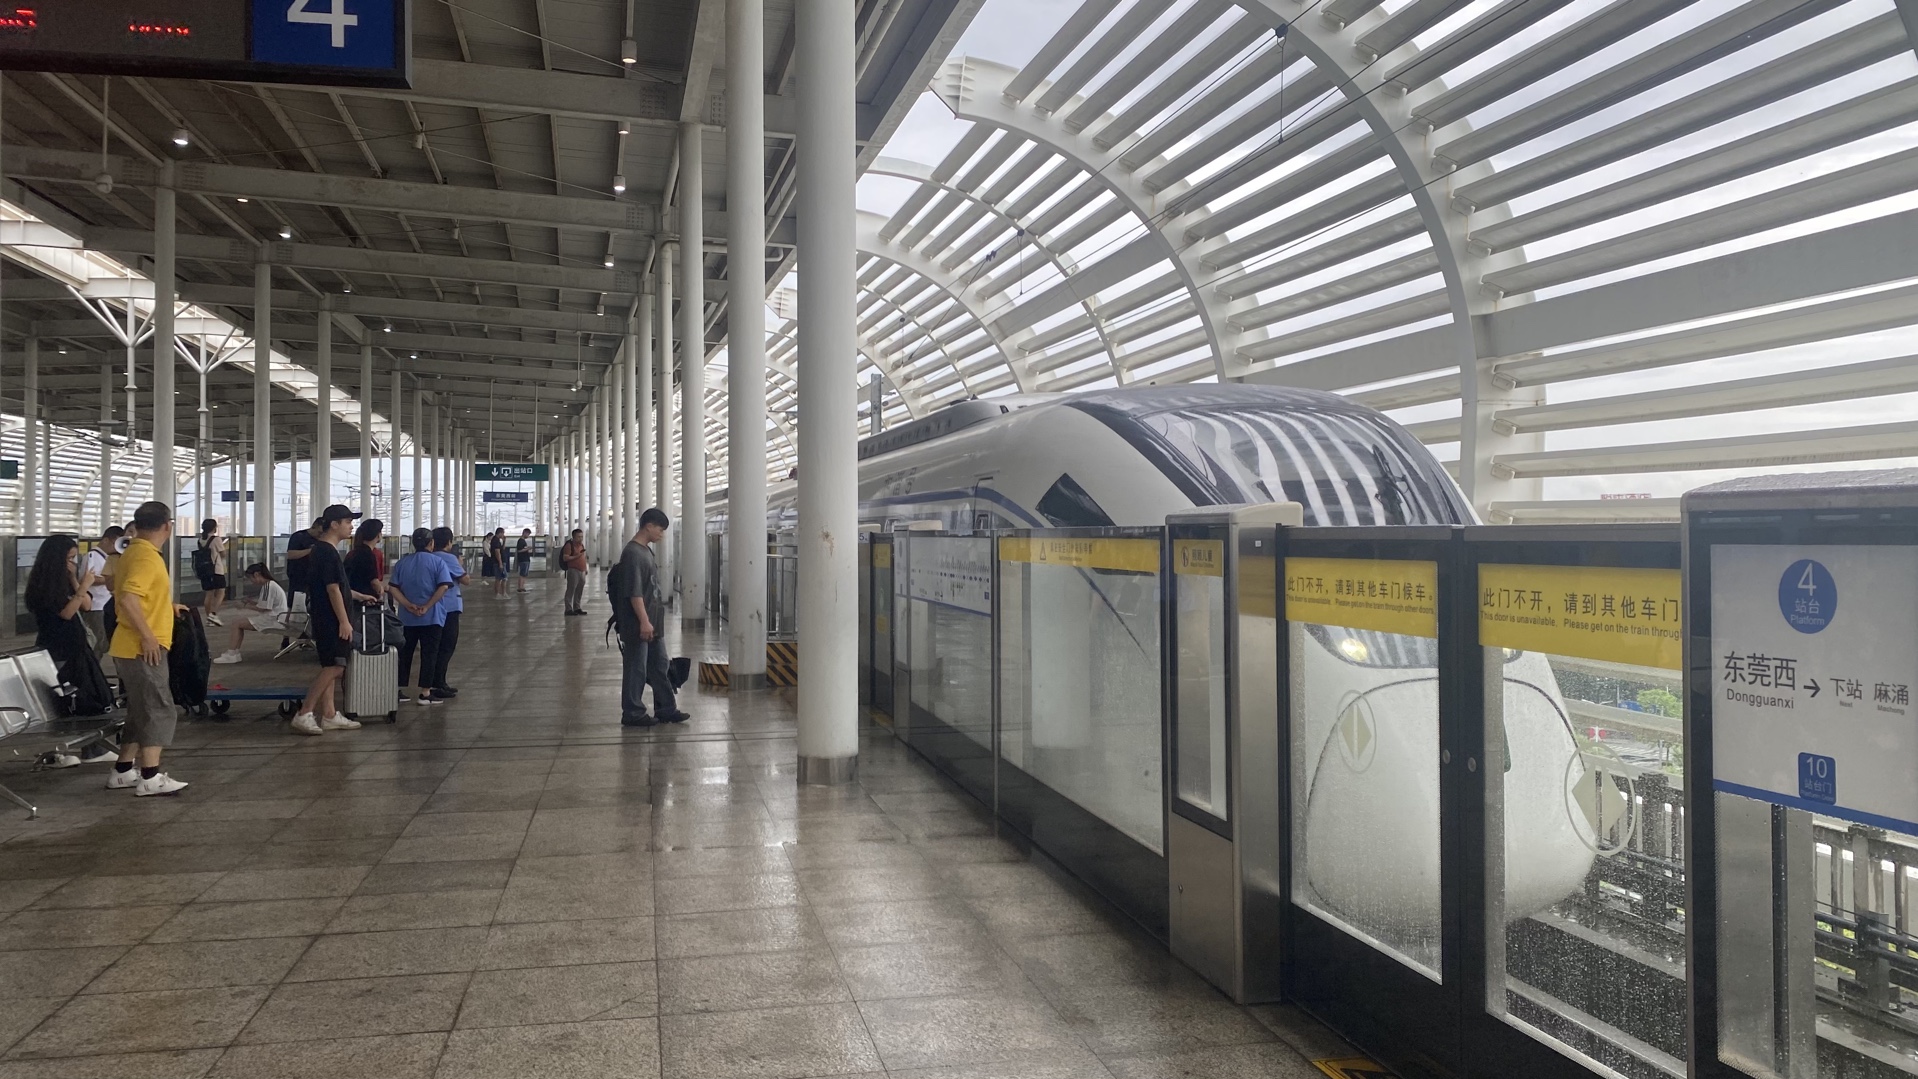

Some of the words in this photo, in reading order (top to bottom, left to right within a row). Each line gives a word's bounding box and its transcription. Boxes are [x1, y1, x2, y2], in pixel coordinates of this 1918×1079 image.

[1797, 562, 1817, 597] 4
[1795, 598, 1820, 614] 站台
[1480, 610, 1493, 621] This
[1494, 613, 1509, 622] door
[1510, 614, 1516, 623] is
[1564, 618, 1589, 630] Please
[1590, 622, 1603, 633] get
[1604, 624, 1614, 632] on
[1616, 623, 1629, 634] the
[1630, 625, 1650, 636] train
[1790, 614, 1825, 626] Platform
[1723, 651, 1797, 691] 东莞西
[1726, 688, 1794, 709] Dongguanxi
[1829, 678, 1863, 700] 下站
[1874, 682, 1909, 706] 麻涌
[1806, 757, 1828, 778] 10
